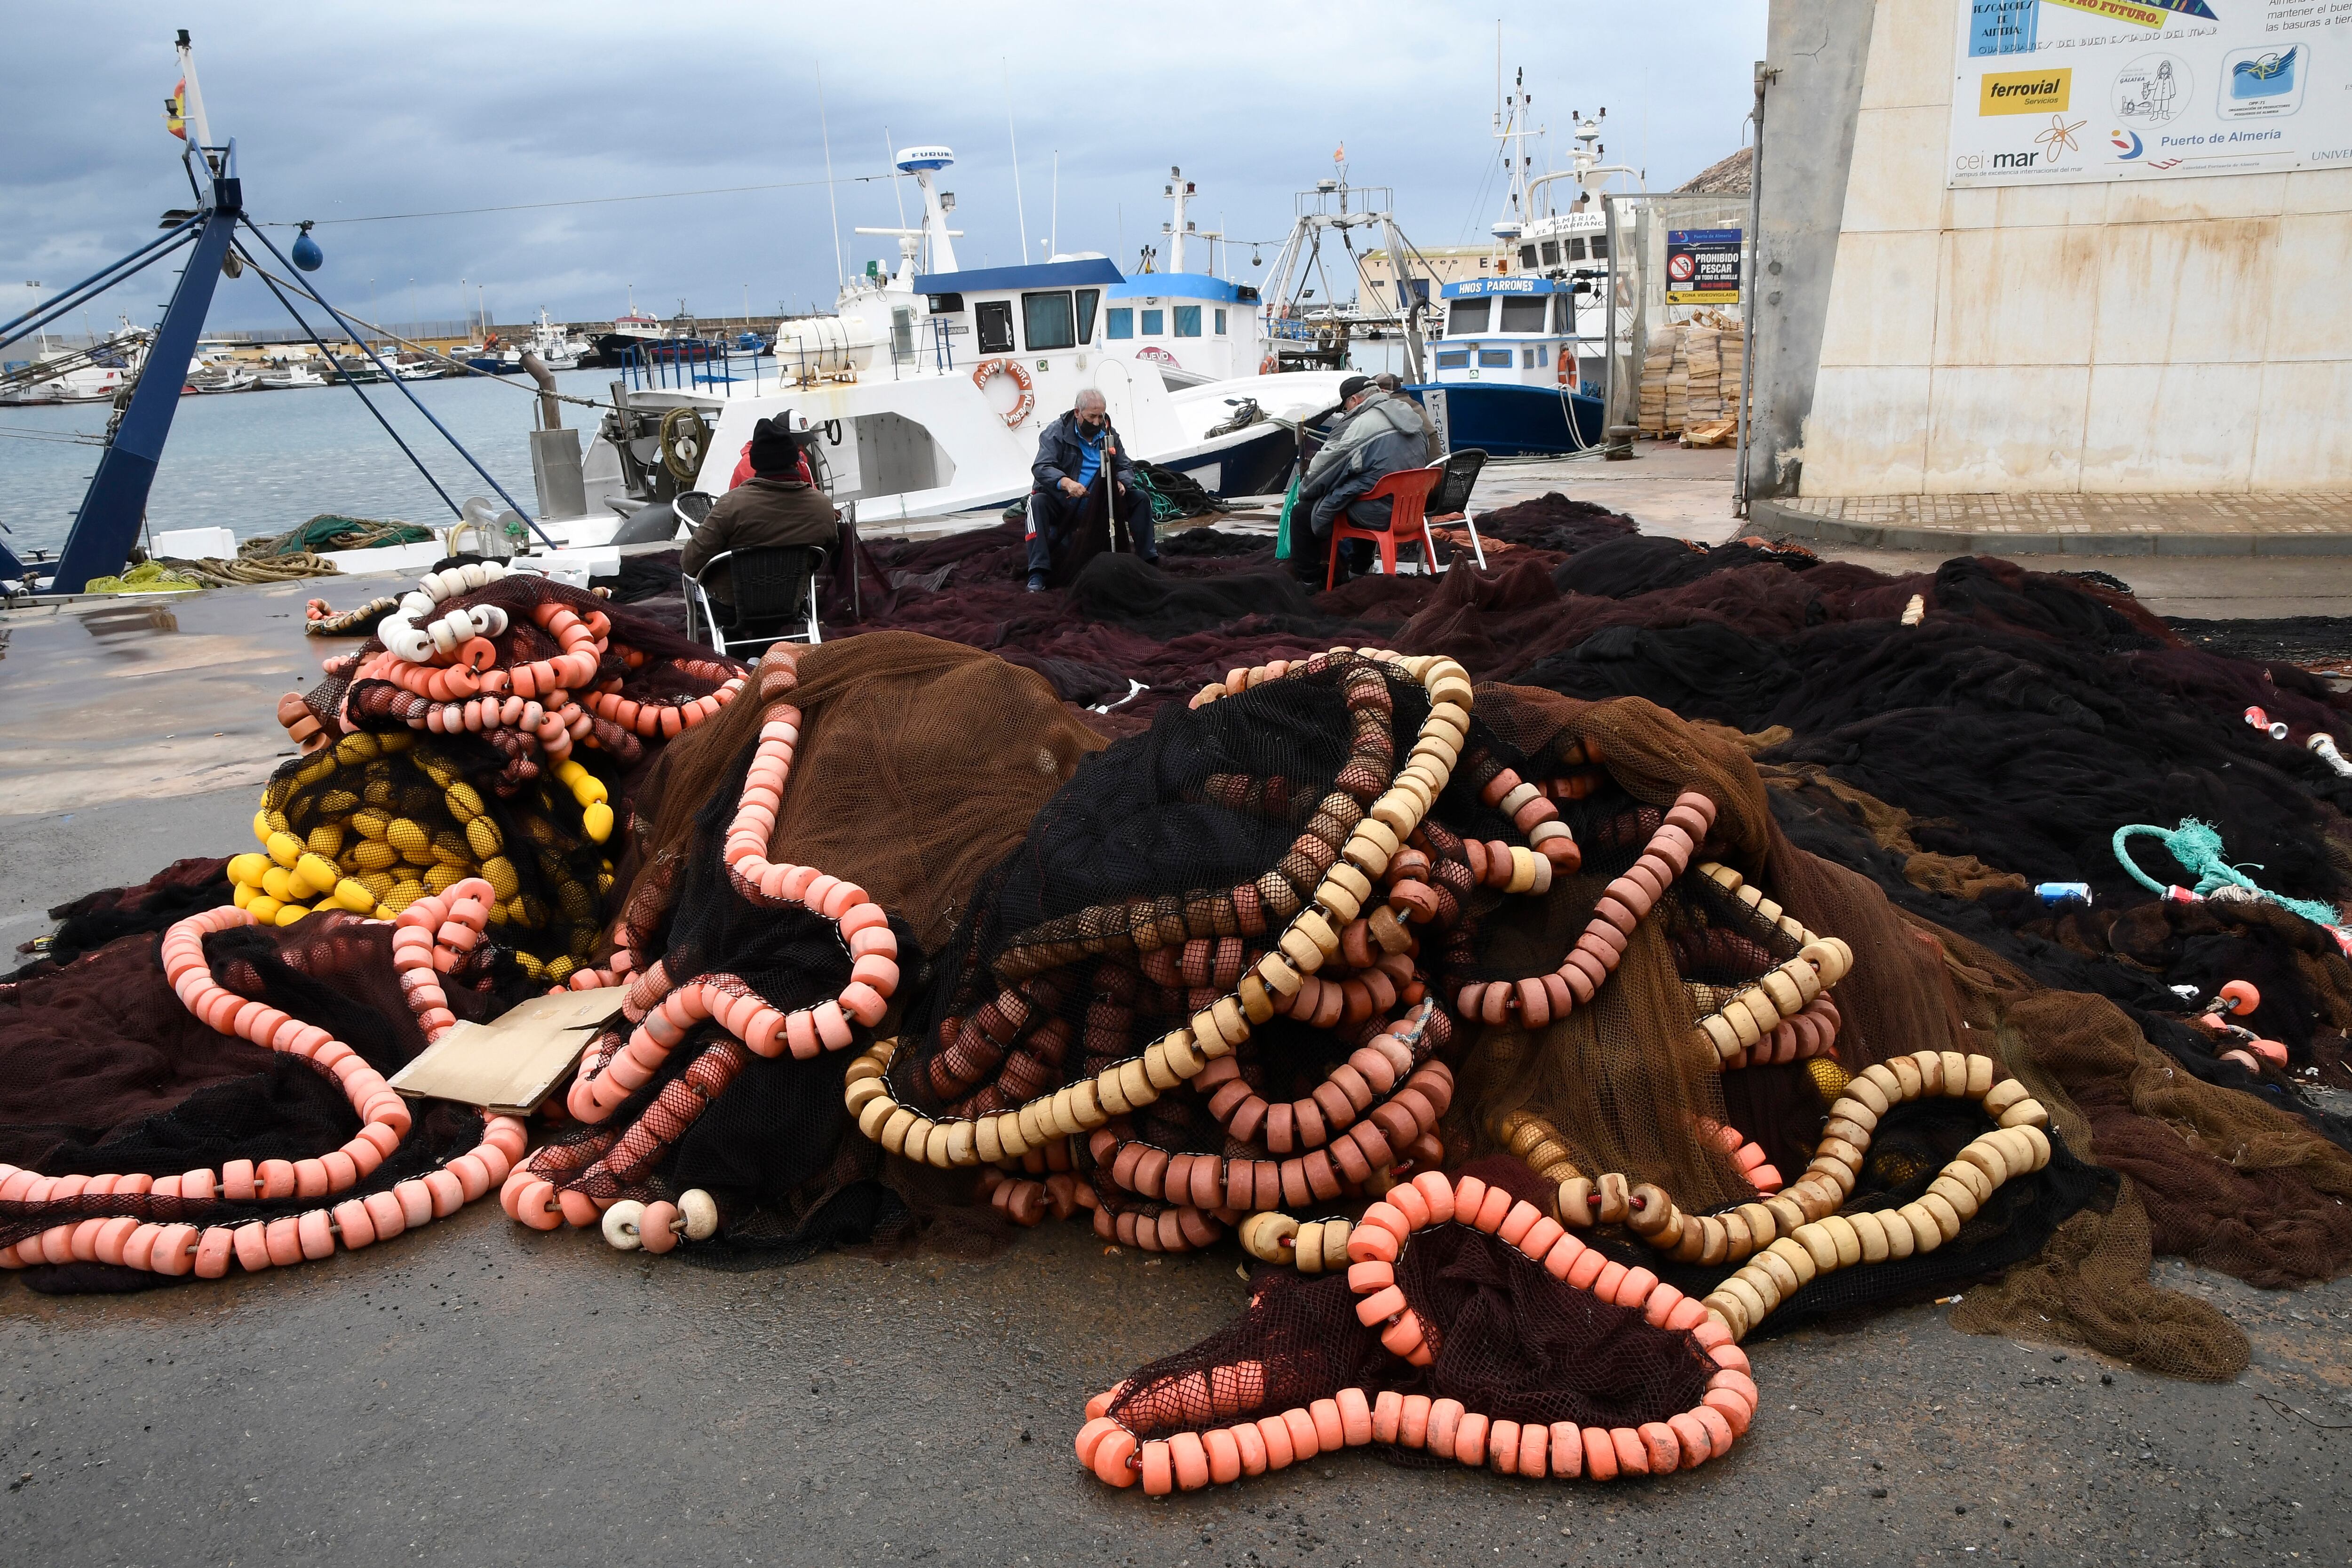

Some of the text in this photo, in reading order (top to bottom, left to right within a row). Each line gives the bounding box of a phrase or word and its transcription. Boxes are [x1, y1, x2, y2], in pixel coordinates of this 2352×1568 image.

[1974, 1, 2033, 14] PESCADORES
[2099, 1, 2159, 24] FUTURO.
[2267, 8, 2314, 19] mantener
[2317, 5, 2326, 14] el
[2283, 20, 2320, 30] basuras
[2336, 15, 2352, 24] tier
[2056, 39, 2075, 48] DEL
[2078, 37, 2106, 46] BUEN
[2109, 32, 2161, 44] ESTADO
[2163, 30, 2184, 40] DEL
[1990, 79, 2060, 97] ferrovial
[2161, 129, 2281, 146] Puerto de Almería
[1557, 221, 1607, 230] BARRANC
[1695, 253, 1739, 263] PROHIBIDO
[1701, 264, 1732, 273] PESCAR
[1459, 280, 1534, 294] HNOS PARRONES
[1010, 363, 1030, 387] PURA
